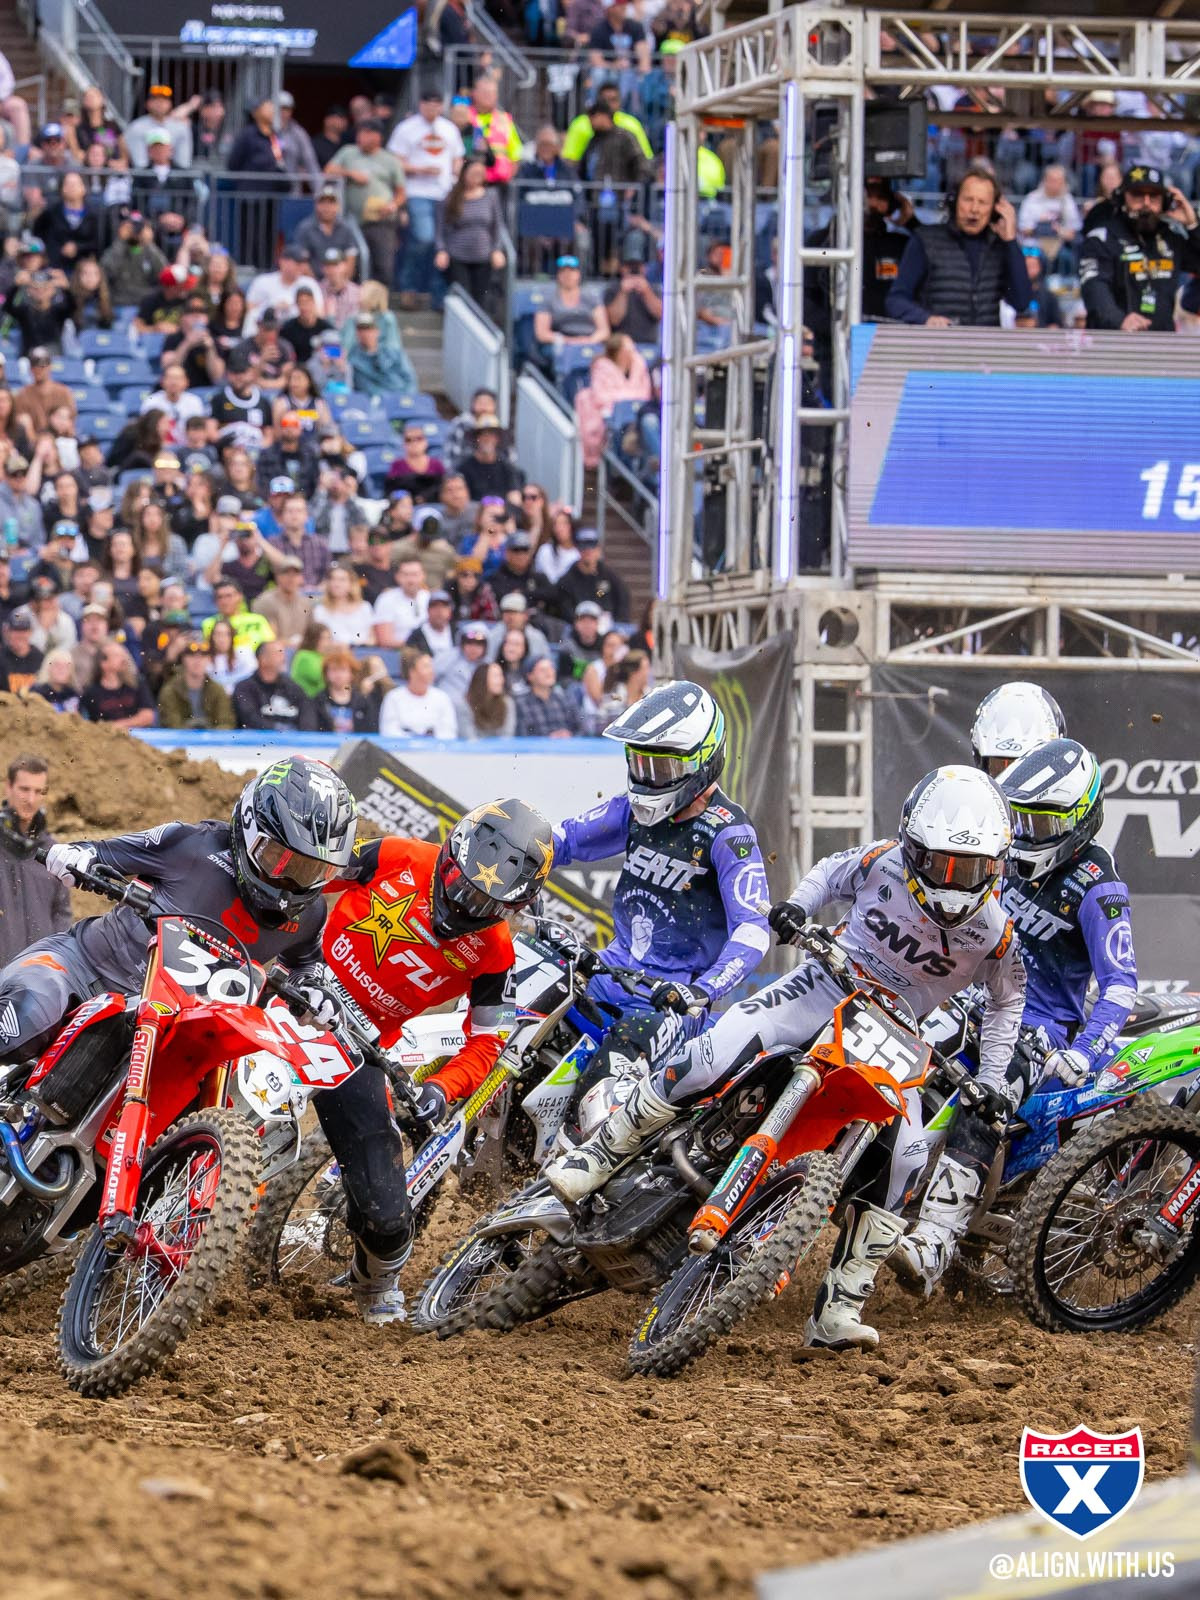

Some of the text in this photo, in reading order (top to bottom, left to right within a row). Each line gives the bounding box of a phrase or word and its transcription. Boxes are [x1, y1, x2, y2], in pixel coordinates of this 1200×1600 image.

[1101, 758, 1200, 795] OCKY
[357, 800, 410, 839] CROS
[364, 792, 430, 839] MOTO
[368, 776, 439, 830] SUPER
[621, 888, 676, 925] HEARTBEAT
[1001, 887, 1074, 941] EATT
[163, 939, 259, 1006] 30
[342, 956, 414, 1016] Husqvarna
[739, 966, 817, 1015] ANVAS
[842, 1011, 919, 1084] 35
[1158, 1013, 1198, 1033] DUNLOP
[106, 1131, 127, 1213] DUNLOP
[404, 1135, 445, 1182] NLOP
